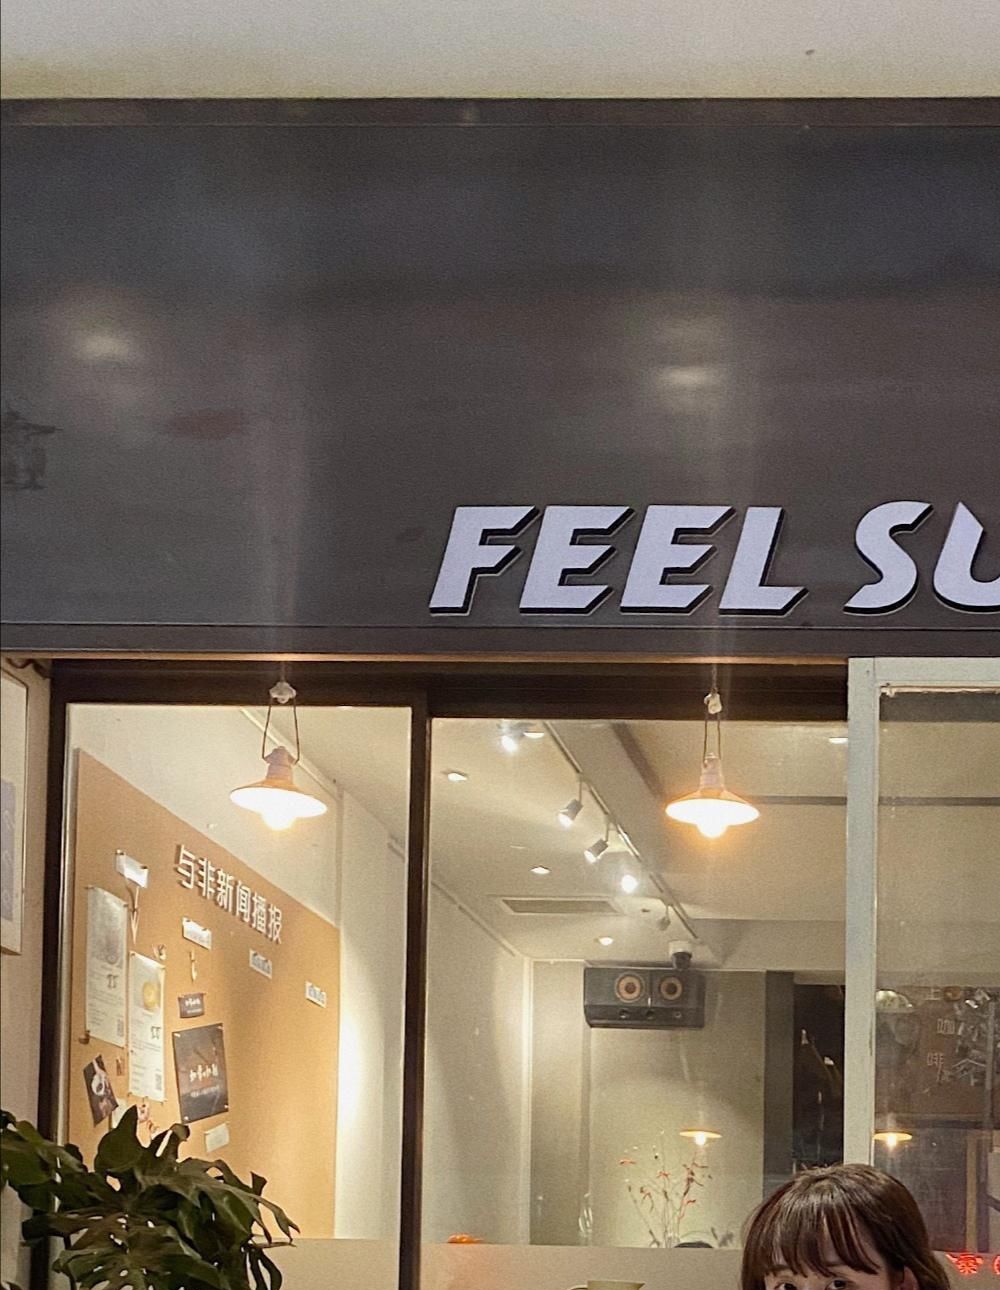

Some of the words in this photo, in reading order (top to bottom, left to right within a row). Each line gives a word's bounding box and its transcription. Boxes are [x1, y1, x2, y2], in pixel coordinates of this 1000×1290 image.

[429, 504, 808, 616] FEEL
[175, 844, 284, 945] 与非新闻播报
